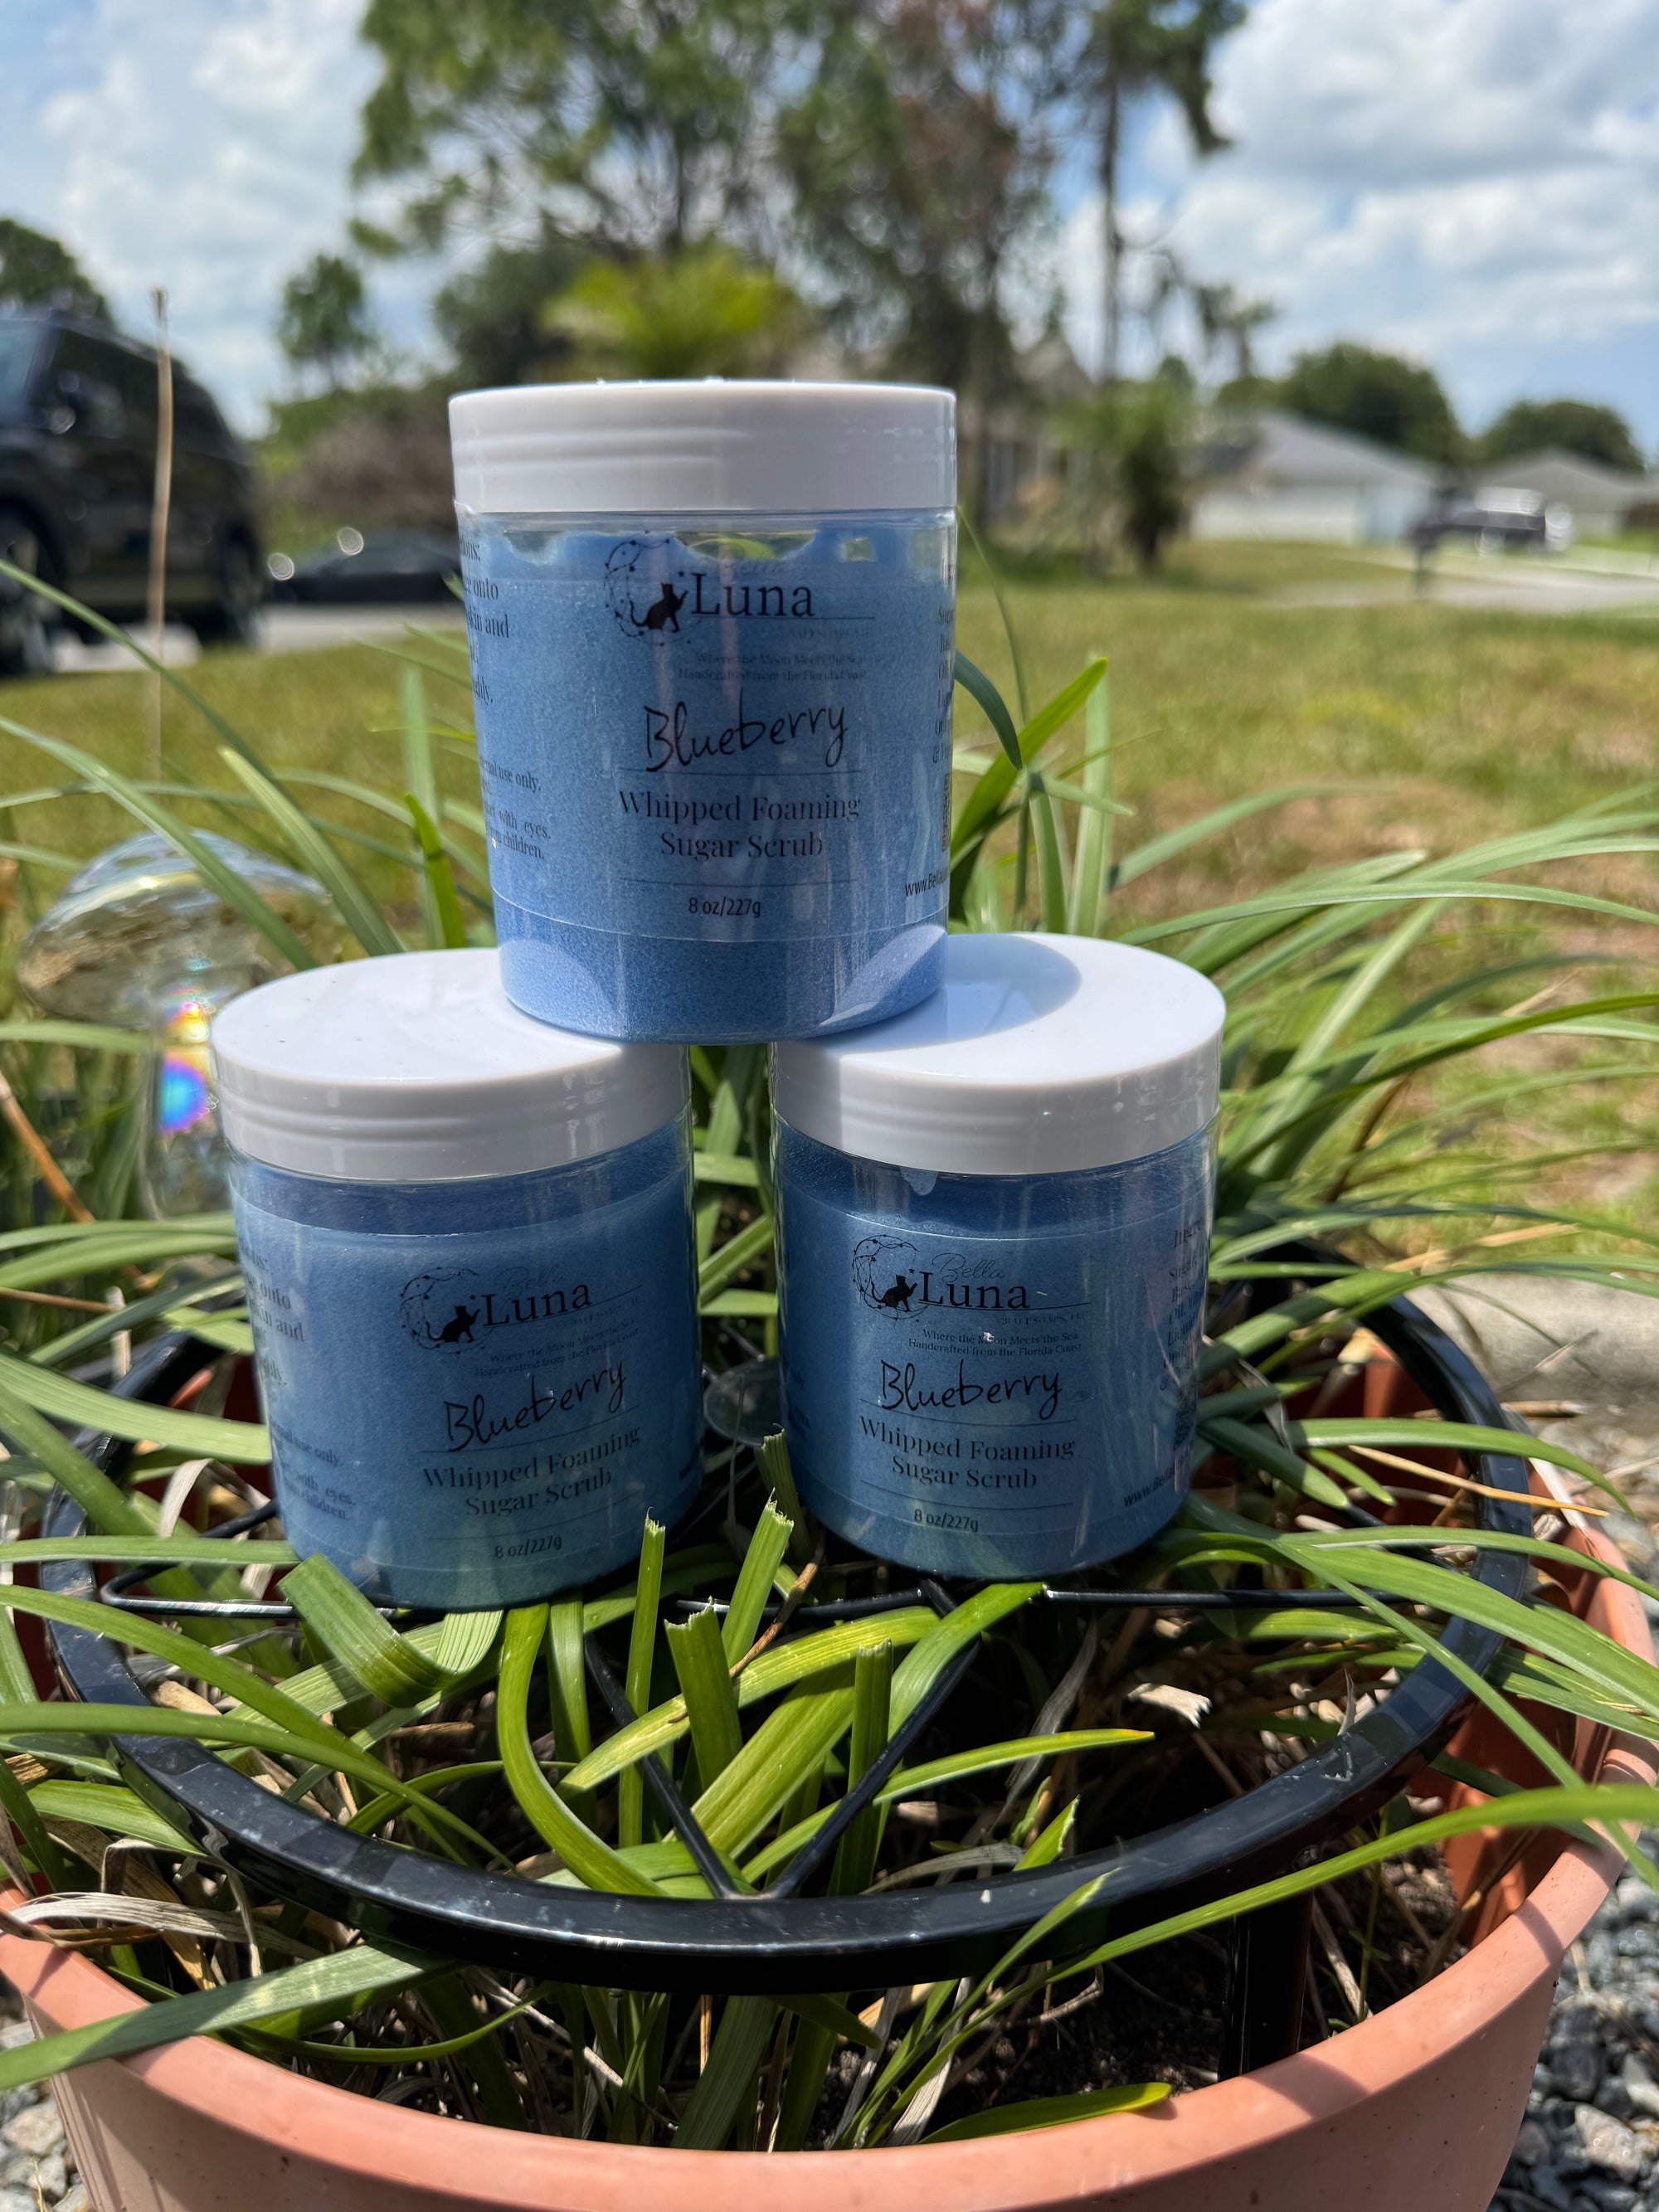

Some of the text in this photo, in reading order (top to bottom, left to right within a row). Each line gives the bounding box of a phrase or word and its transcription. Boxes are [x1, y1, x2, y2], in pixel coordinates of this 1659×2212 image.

[474, 577, 499, 600] onto
[690, 571, 815, 618] Luna
[485, 613, 510, 639] and
[644, 687, 849, 772] Blueberry
[499, 766, 513, 784] use
[619, 790, 860, 825] Whipped Foaming
[499, 809, 518, 830] with
[523, 820, 552, 839] eyes.
[503, 831, 545, 860] children.
[659, 829, 823, 863] Sugar Scrub
[688, 896, 762, 919] 8 oz/227g
[932, 1252, 1005, 1284] Bella
[260, 1283, 291, 1310] onto
[481, 1283, 592, 1327] Luna
[918, 1271, 1030, 1309] Luna
[275, 1318, 304, 1342] and
[922, 1329, 1078, 1346] Where the Mon Meets the Sea
[907, 1338, 1082, 1358] Handcrafted from the Florida Coast
[880, 1358, 1063, 1421] Blueberry
[444, 1360, 627, 1452] Blueberry
[860, 1415, 1076, 1461] Whipped Foaming
[423, 1456, 538, 1491] Whipped
[548, 1426, 641, 1475] Foaming
[892, 1455, 1038, 1489] Sugar Scrub
[466, 1467, 612, 1517] Sugar Scrub
[914, 1508, 979, 1534] 8 oz/227g
[494, 1535, 562, 1559] 8 oz/227g
